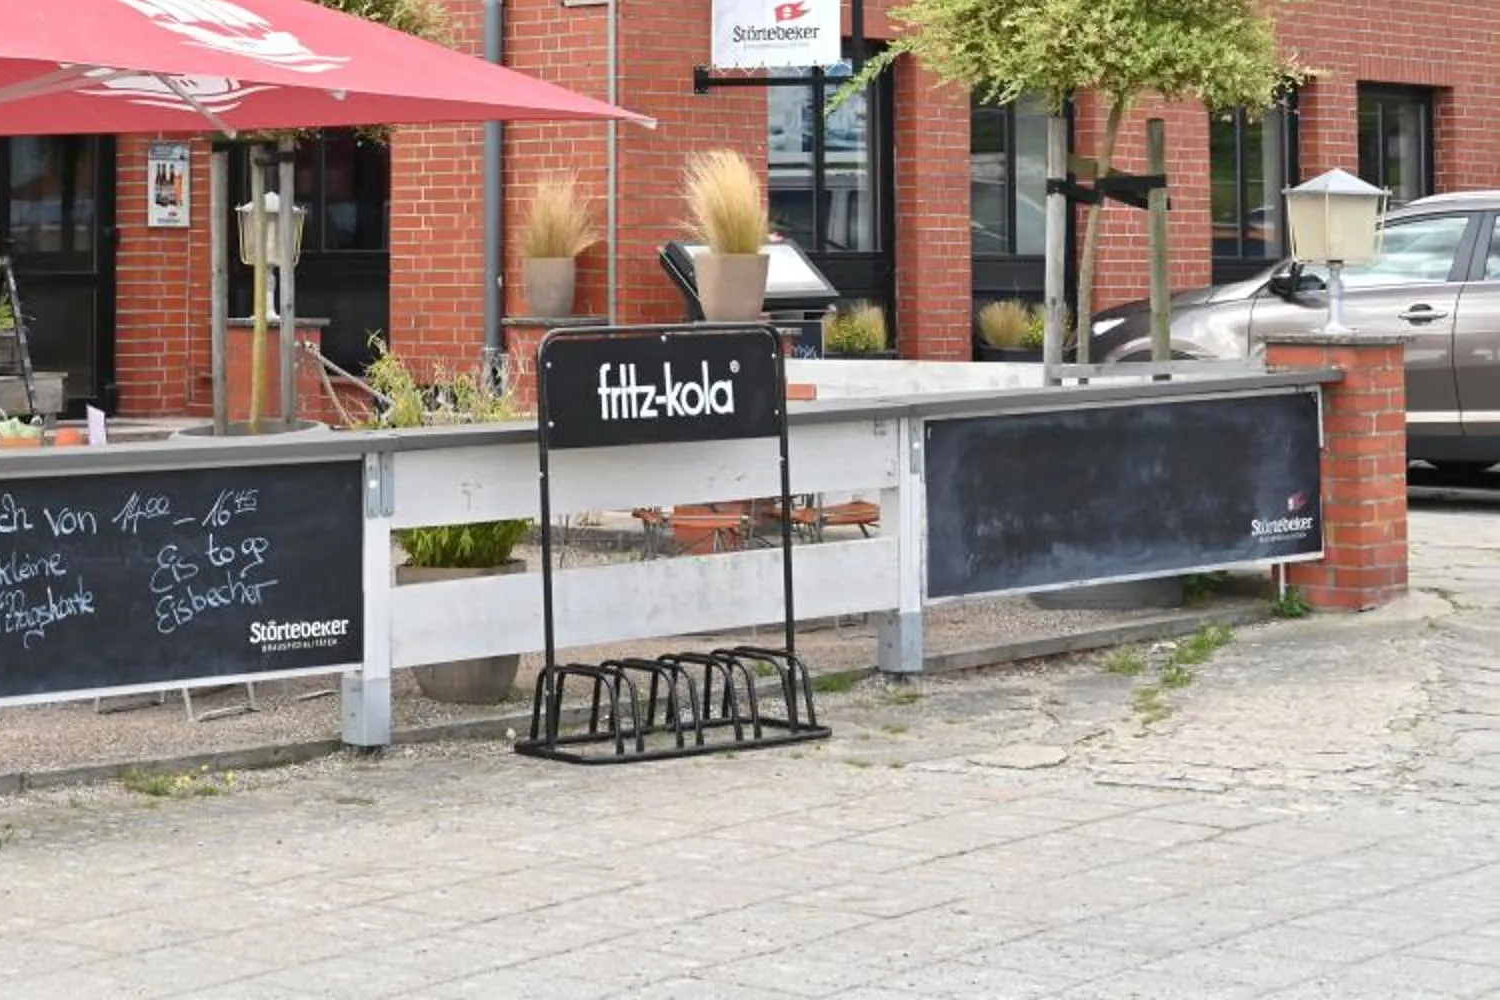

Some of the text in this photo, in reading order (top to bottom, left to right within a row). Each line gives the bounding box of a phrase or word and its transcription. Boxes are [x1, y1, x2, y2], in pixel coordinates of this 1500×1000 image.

[732, 24, 820, 43] Störtebeker
[150, 533, 269, 593] Eis to go
[156, 570, 279, 634] Eisbecher
[249, 619, 350, 645] Störtebeker
